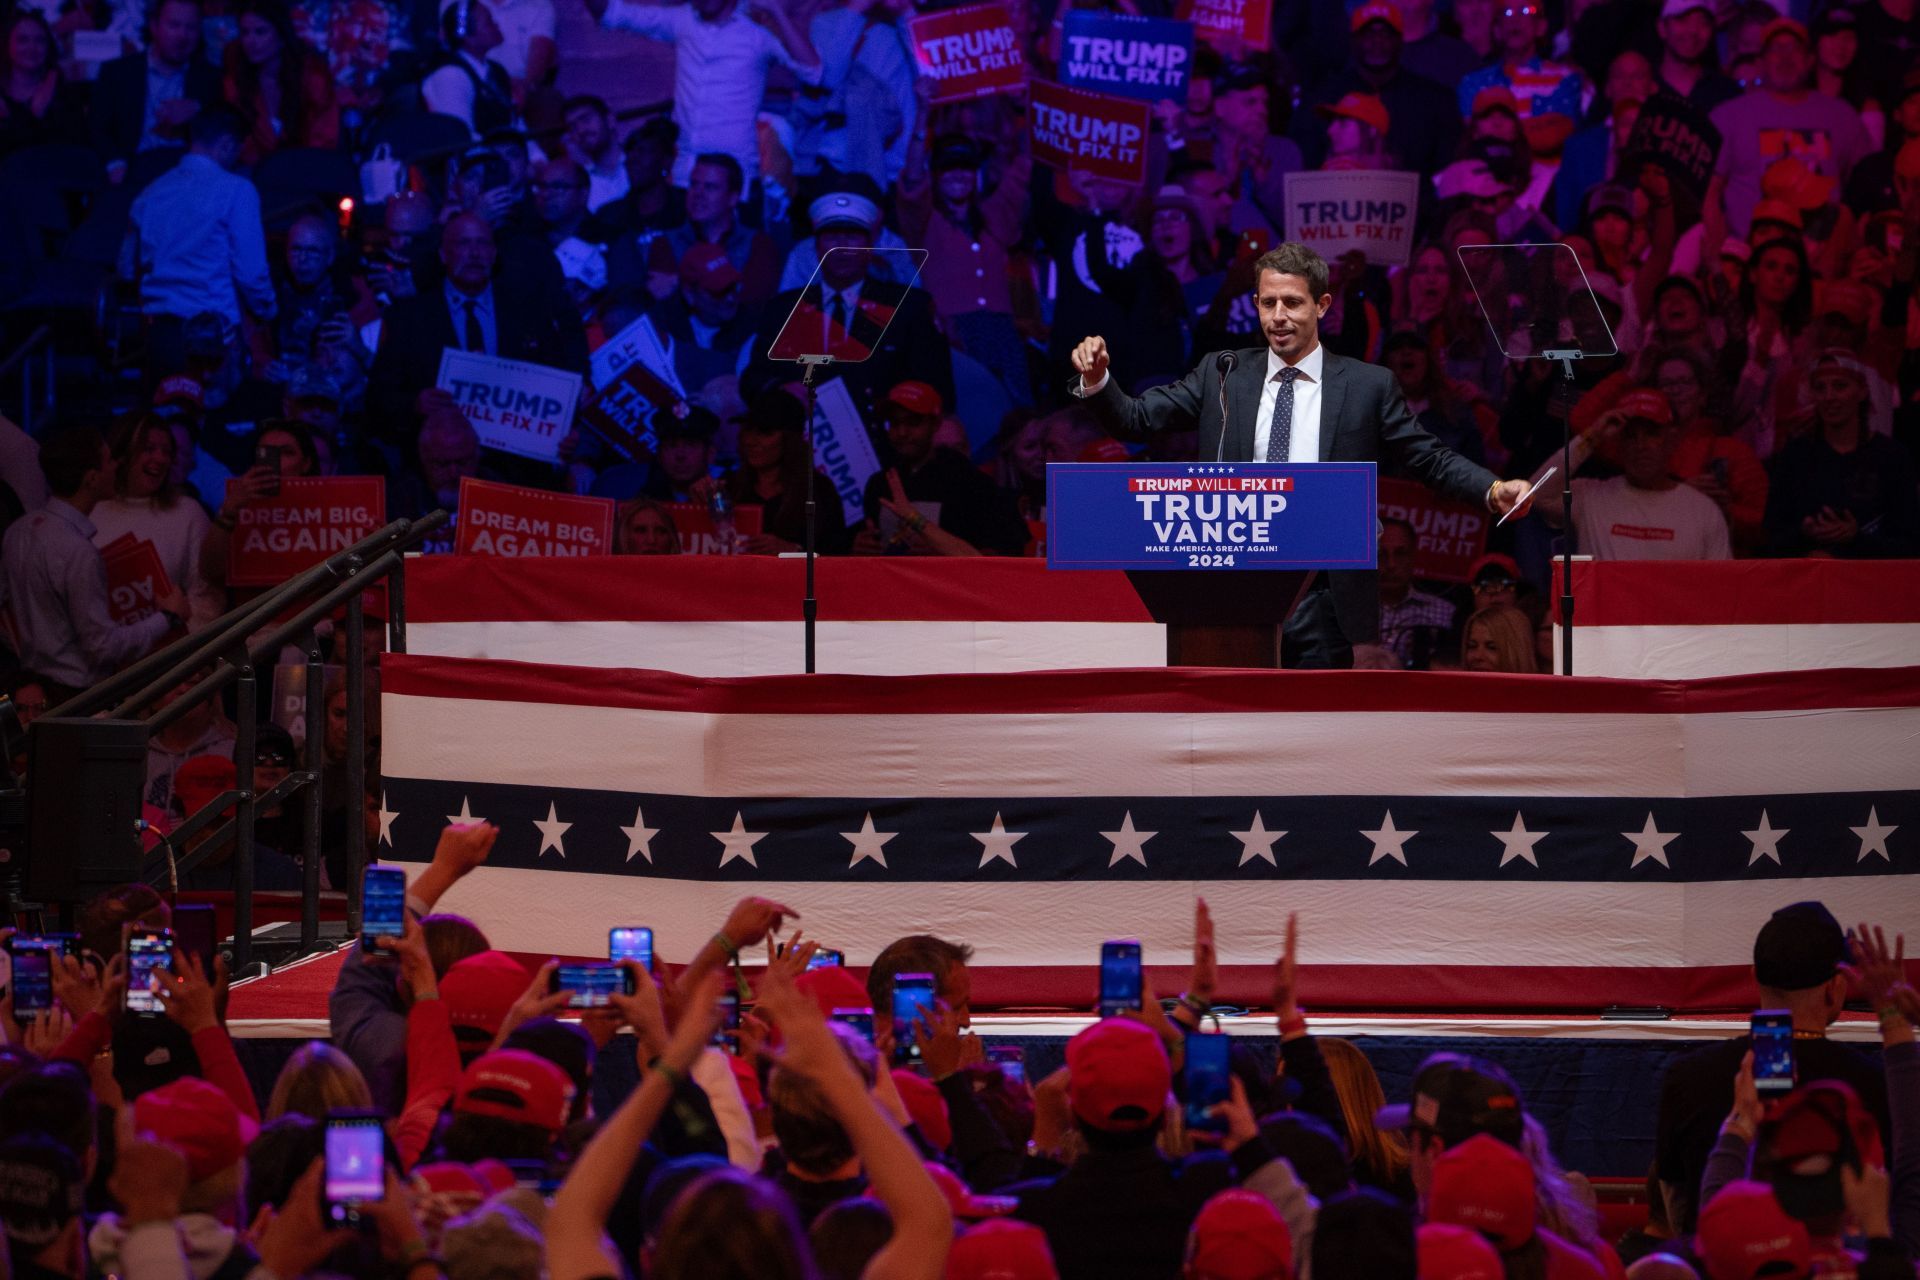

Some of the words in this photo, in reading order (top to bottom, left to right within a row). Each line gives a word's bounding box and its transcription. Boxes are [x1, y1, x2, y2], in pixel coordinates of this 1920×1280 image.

[922, 26, 1016, 64] TRUMP
[1068, 35, 1188, 70] TRUMP
[929, 59, 978, 80] WILL
[979, 51, 1008, 72] FIX
[1008, 48, 1022, 66] IT
[1067, 62, 1122, 82] WILL
[1125, 66, 1162, 86] FIX
[1164, 70, 1185, 87] IT
[1031, 101, 1142, 147] TRUMP
[1032, 126, 1074, 154] WILL
[1078, 139, 1112, 160] FIX
[1117, 147, 1139, 164] IT
[1297, 200, 1407, 223] TRUMP
[1299, 224, 1349, 240] WILL
[1355, 223, 1384, 239] FIX
[1388, 226, 1404, 242] IT
[450, 379, 562, 419] TRUMP
[501, 411, 532, 431] FIX
[537, 421, 557, 437] IT
[1135, 478, 1193, 491] TRUMP
[1197, 478, 1237, 491] WILL
[1241, 478, 1269, 491] FIX
[1272, 478, 1287, 491] IT
[238, 506, 322, 525] DREAM
[328, 505, 376, 527] BIG,
[1135, 494, 1288, 521] TRUMP
[470, 507, 550, 538] DREAM
[556, 522, 601, 547] BIG,
[1152, 521, 1270, 543] VANCE
[1215, 545, 1244, 553] GREAT
[1248, 545, 1278, 553] AGAIN!
[1417, 534, 1452, 555] FIX
[1456, 540, 1477, 557] IT
[1188, 554, 1235, 567] 2024
